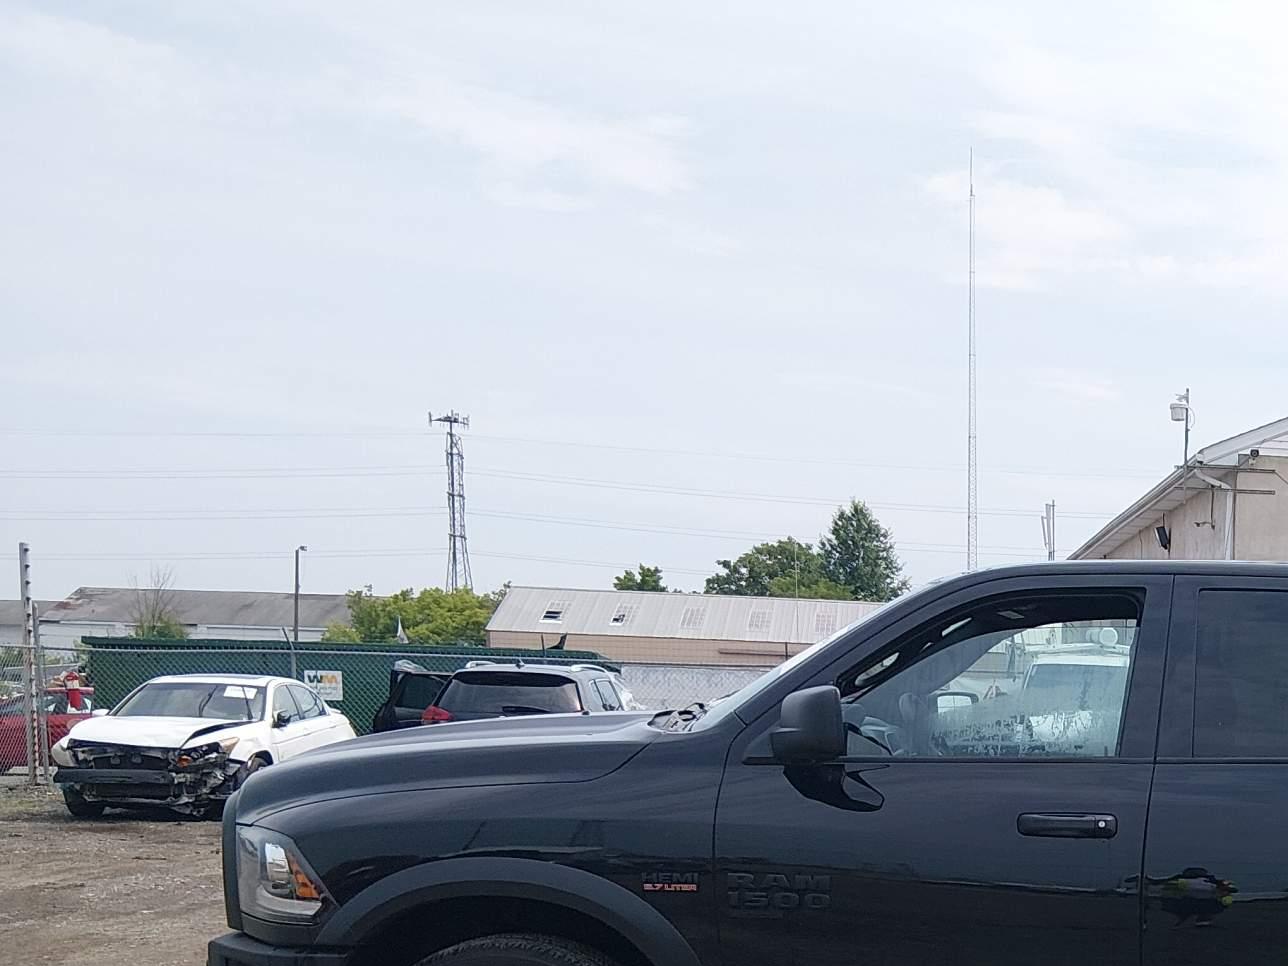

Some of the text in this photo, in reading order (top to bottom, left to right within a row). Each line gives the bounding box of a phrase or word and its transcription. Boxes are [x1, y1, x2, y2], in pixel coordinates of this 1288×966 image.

[641, 872, 699, 883] HEMI
[727, 872, 832, 889] RAM
[727, 891, 832, 909] 1500
